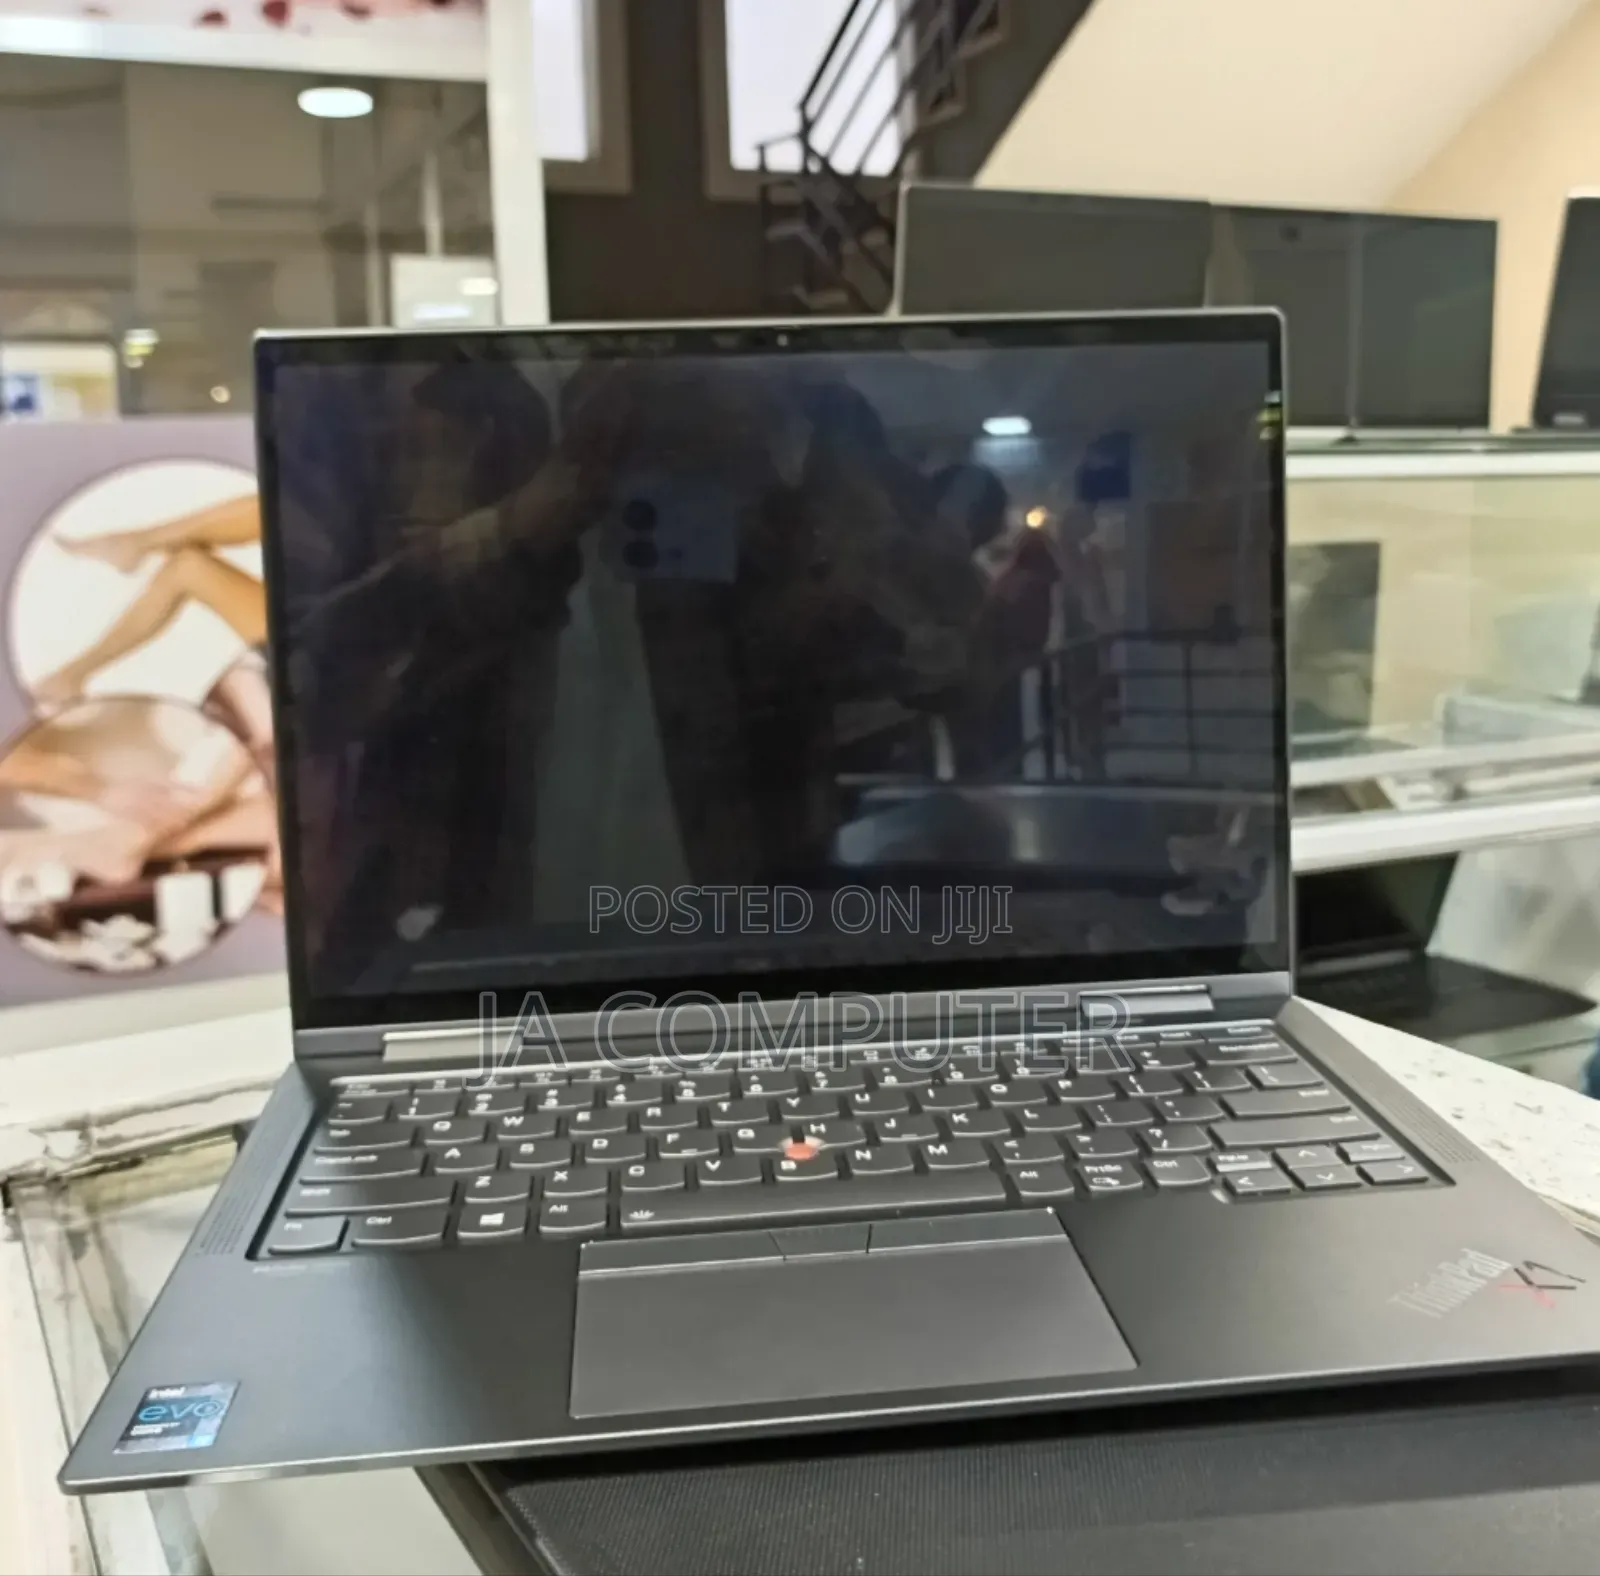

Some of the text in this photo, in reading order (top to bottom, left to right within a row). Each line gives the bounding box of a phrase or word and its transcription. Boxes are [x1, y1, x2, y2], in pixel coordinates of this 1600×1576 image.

[786, 1096, 800, 1107] Y
[854, 1092, 871, 1103] U
[717, 1101, 731, 1112] T
[952, 1112, 970, 1124] K
[1023, 1108, 1039, 1119] L
[503, 1115, 524, 1127] W
[884, 1117, 897, 1129] J
[809, 1122, 827, 1134] H
[592, 1137, 609, 1149] D
[666, 1132, 681, 1144] F
[444, 1147, 461, 1159] A
[855, 1149, 872, 1161] N
[927, 1143, 949, 1156] M
[705, 1160, 721, 1172] V
[474, 1175, 492, 1188] Z
[553, 1170, 569, 1182] X
[138, 1400, 222, 1422] evo
